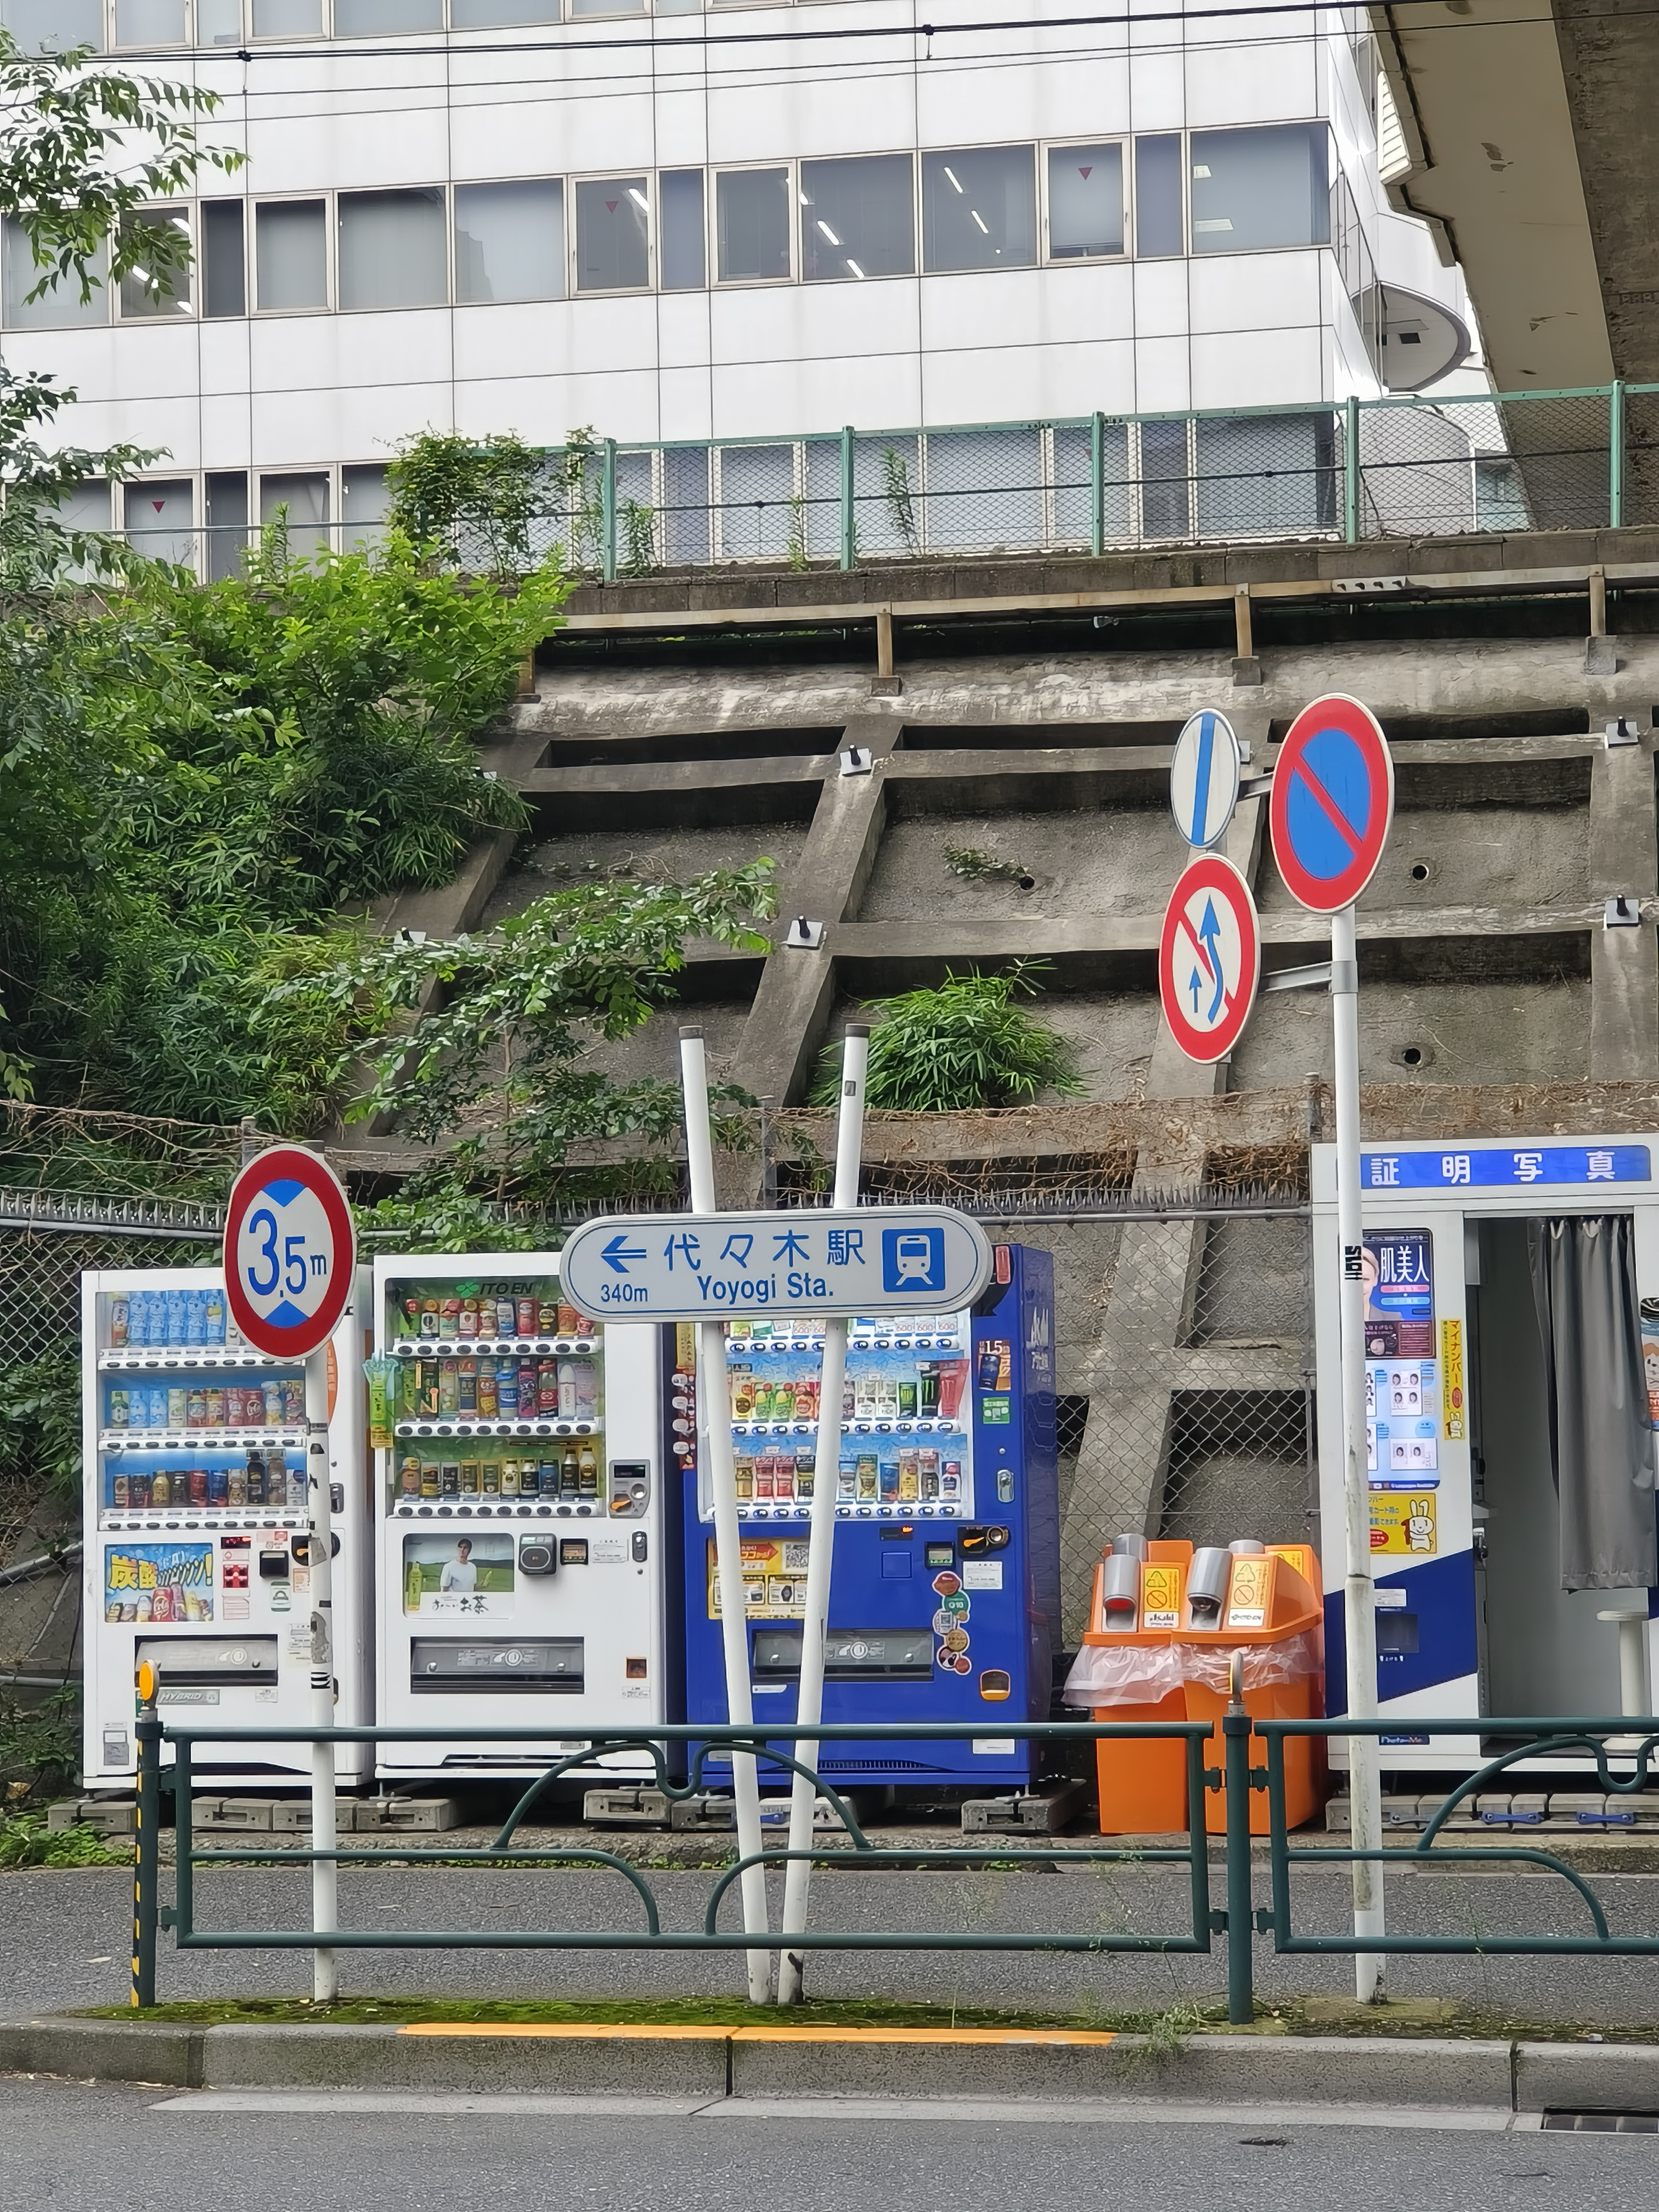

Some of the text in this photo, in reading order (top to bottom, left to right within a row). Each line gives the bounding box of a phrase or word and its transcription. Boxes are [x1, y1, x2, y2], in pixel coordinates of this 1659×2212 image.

[1370, 1150, 1616, 1186] 証明写真
[663, 1229, 866, 1272] 代々木駅
[1380, 1244, 1430, 1284] 肌美人
[479, 1282, 534, 1295] ITO EN
[600, 1284, 648, 1304] 340m
[697, 1272, 834, 1305] Yoyogi Sta.
[1449, 1320, 1462, 1384] マイナンバー
[158, 1691, 203, 1703] HYBRID
